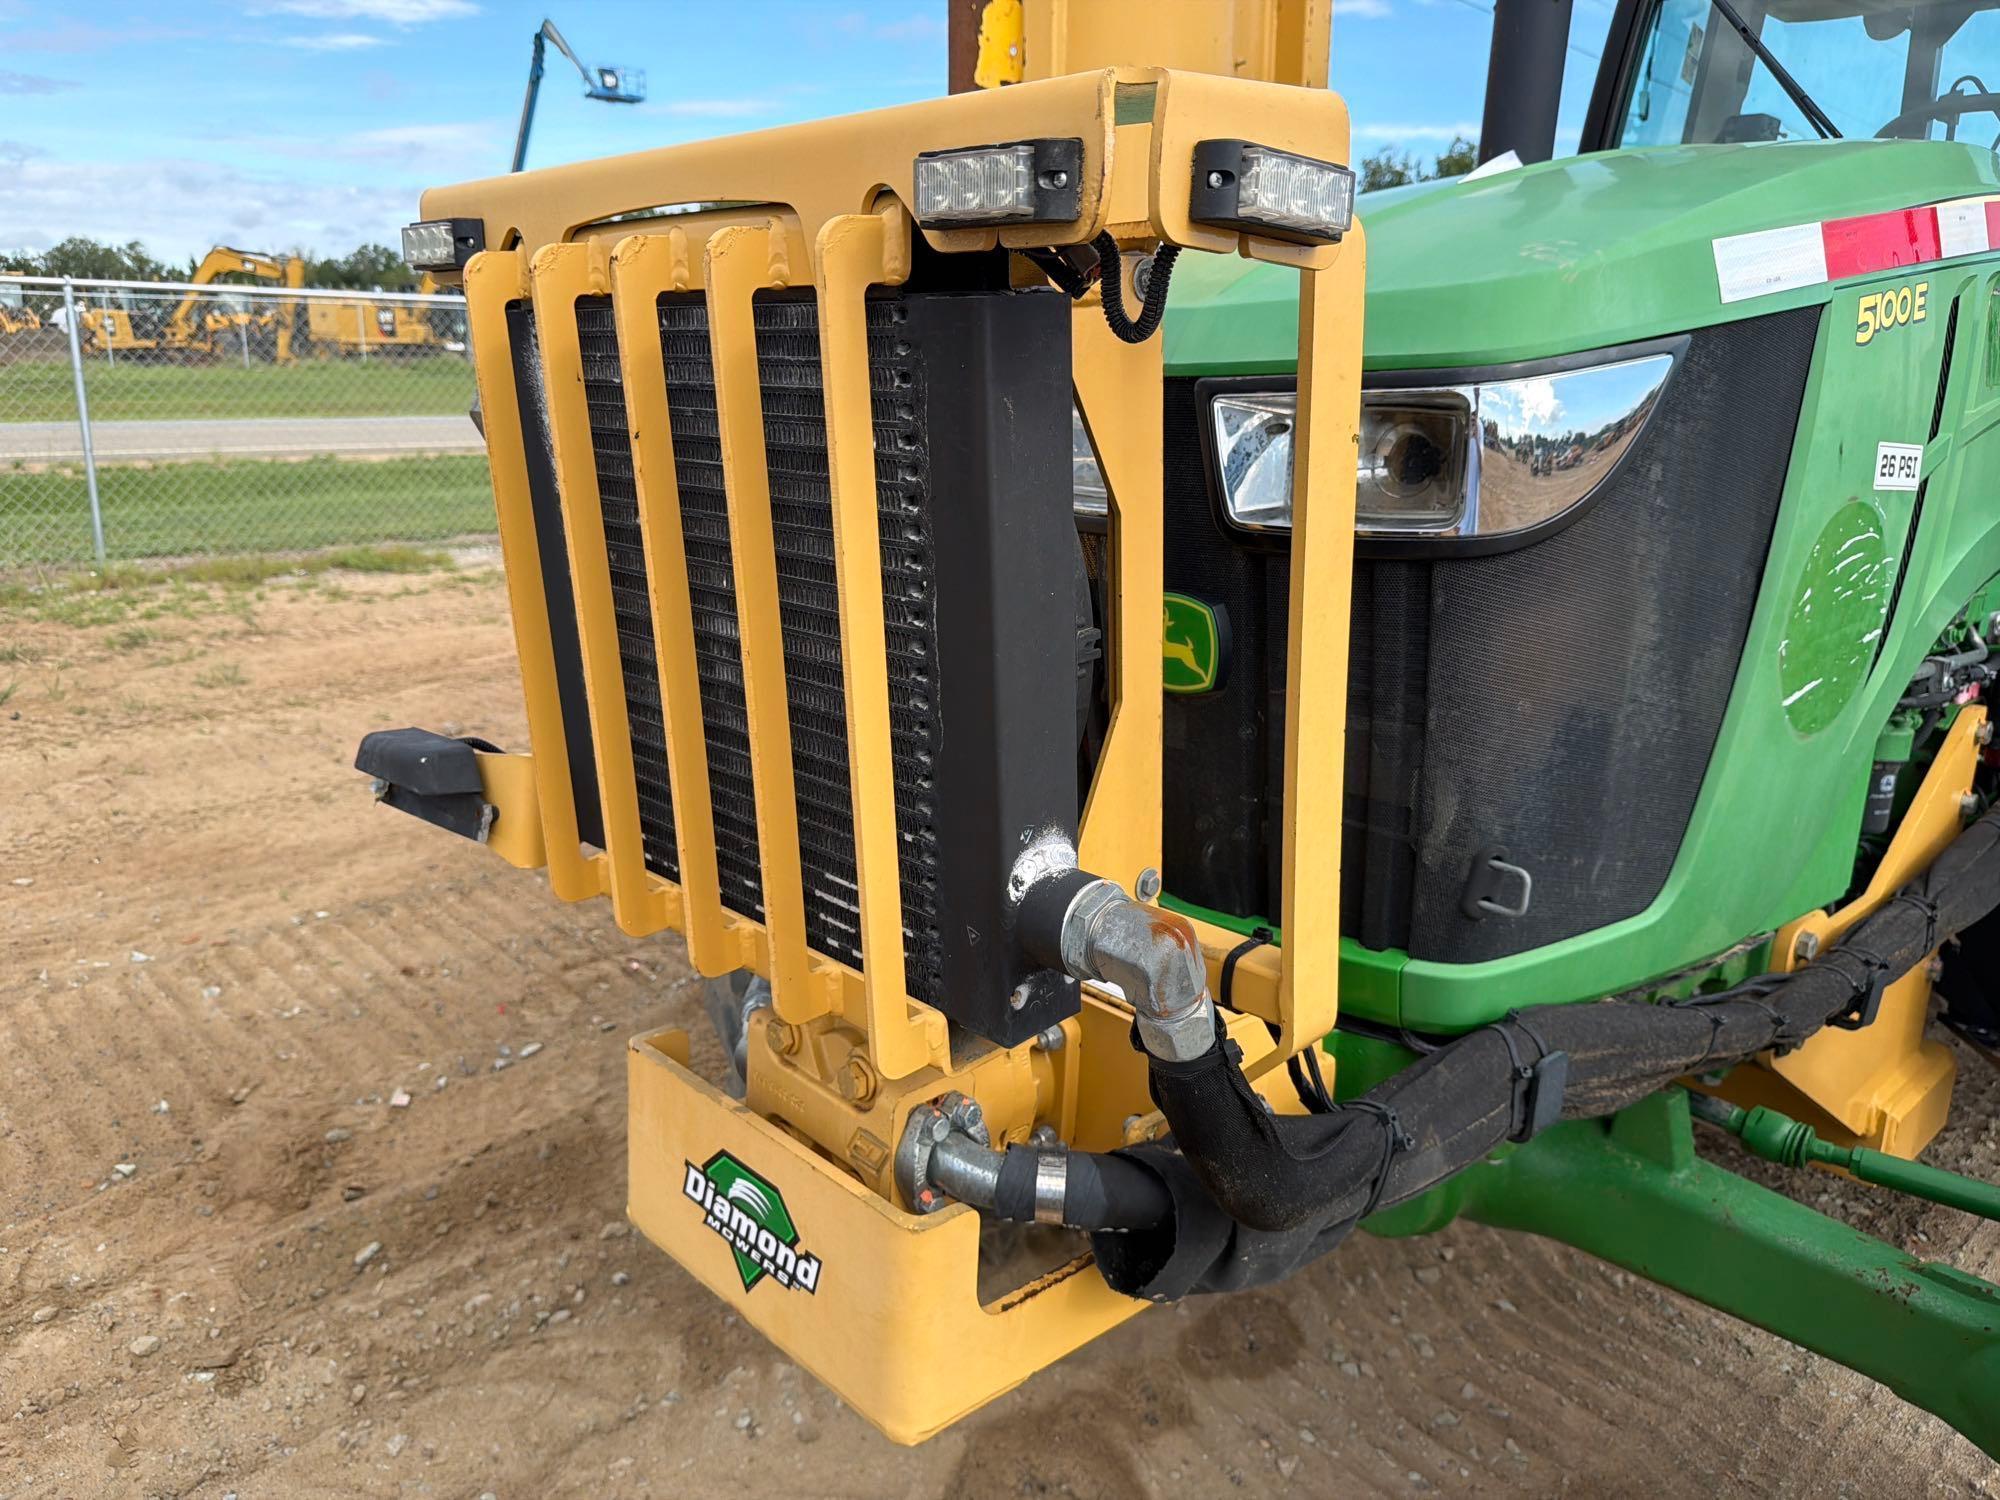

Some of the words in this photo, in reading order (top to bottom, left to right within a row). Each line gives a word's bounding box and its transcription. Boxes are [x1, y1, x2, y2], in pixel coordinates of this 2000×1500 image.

[1856, 282, 1929, 344] 5100E
[1880, 454, 1896, 478] 26
[1897, 455, 1918, 479] PSI
[685, 1165, 819, 1290] Diamond
[706, 1215, 789, 1286] MOWERS
